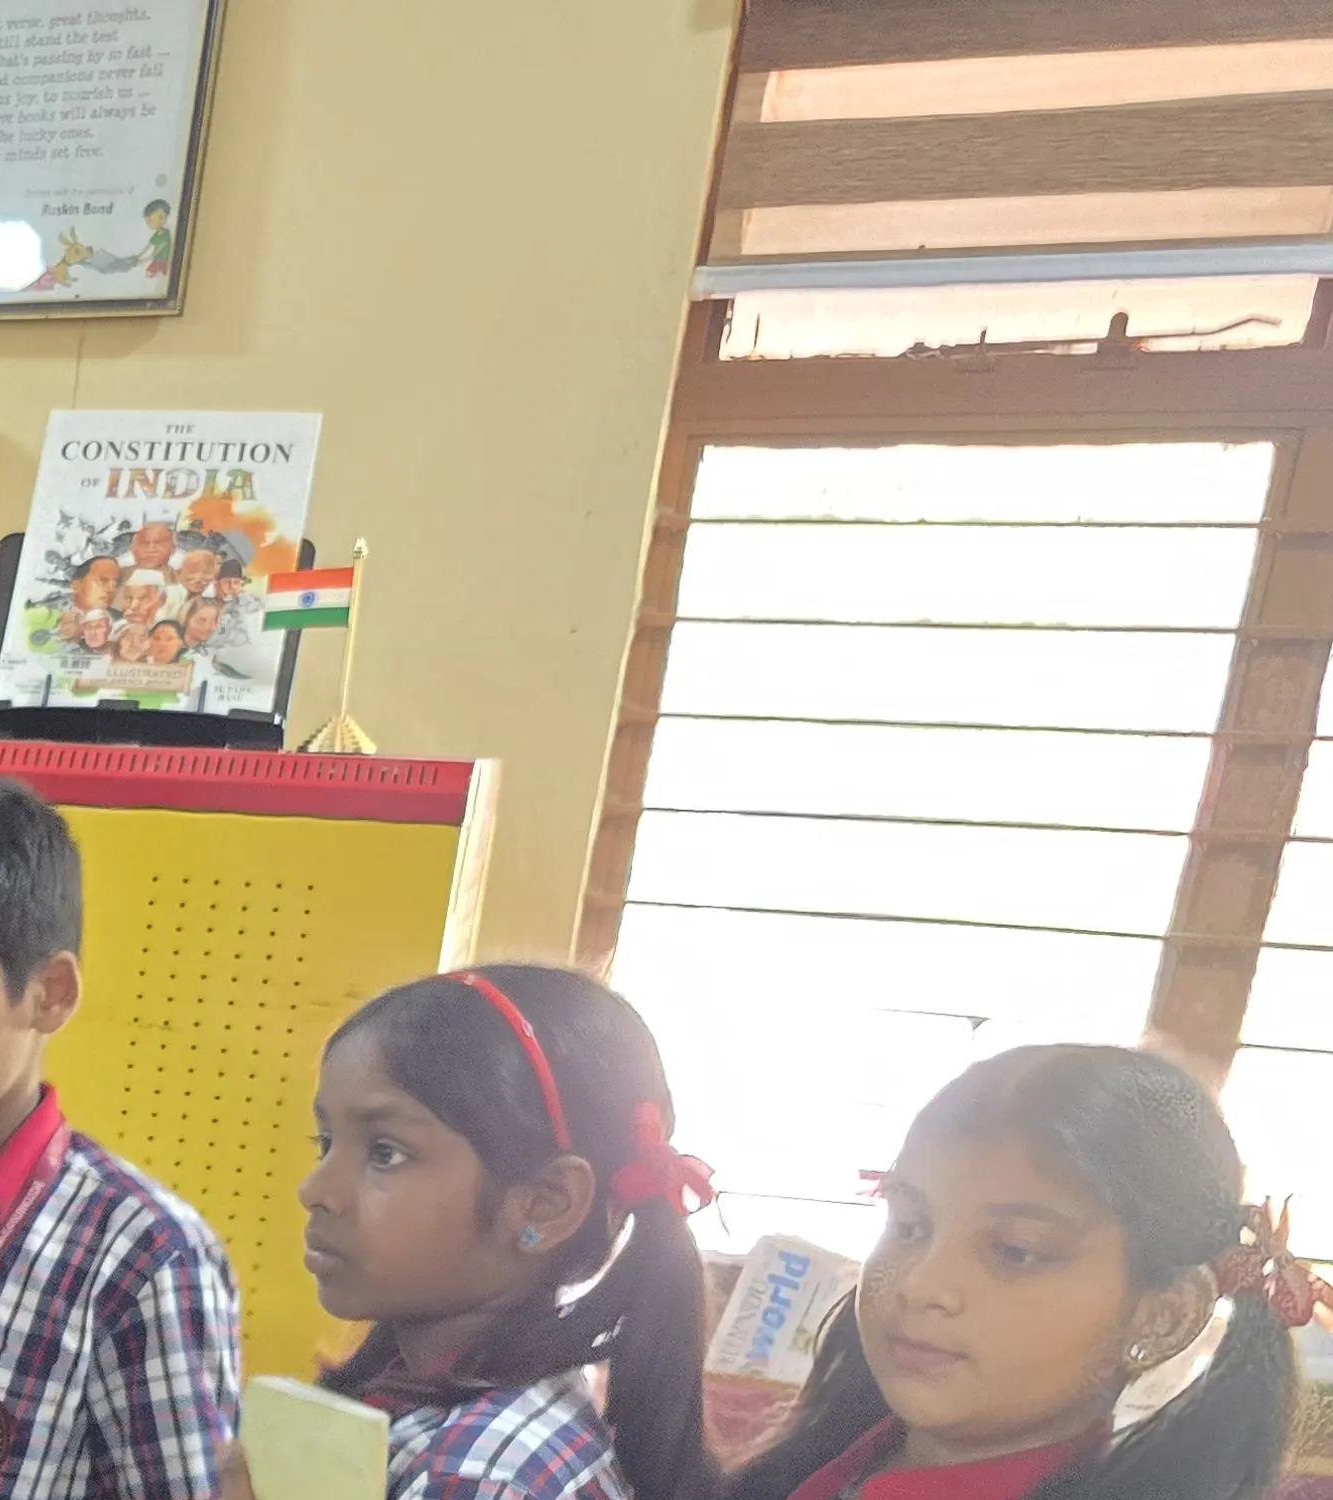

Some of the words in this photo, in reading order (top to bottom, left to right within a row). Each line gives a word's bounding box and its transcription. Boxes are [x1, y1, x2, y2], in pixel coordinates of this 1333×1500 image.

[48, 13, 82, 30] great
[24, 32, 63, 48] stand
[65, 30, 89, 45] the
[92, 29, 119, 44] test
[32, 51, 83, 69] passing
[86, 49, 104, 64] by
[107, 49, 122, 61] so
[126, 45, 153, 60] fast
[12, 68, 93, 87] companions
[98, 67, 136, 81] never
[139, 63, 165, 79] fail
[43, 91, 57, 103] to
[62, 87, 114, 102] nourish
[118, 87, 133, 98] us
[18, 107, 56, 124] books
[60, 106, 85, 121] will
[90, 105, 136, 121] always
[141, 103, 157, 117] be
[18, 127, 56, 145] lucky
[5, 146, 46, 162] minds
[50, 145, 70, 160] set
[41, 202, 78, 217] Ruskin
[83, 201, 114, 216] Bond
[165, 424, 195, 434] THE
[60, 440, 295, 463] CONSTITUTION
[80, 477, 102, 489] OF
[104, 467, 258, 500] INDIA
[746, 1250, 811, 1360] world
